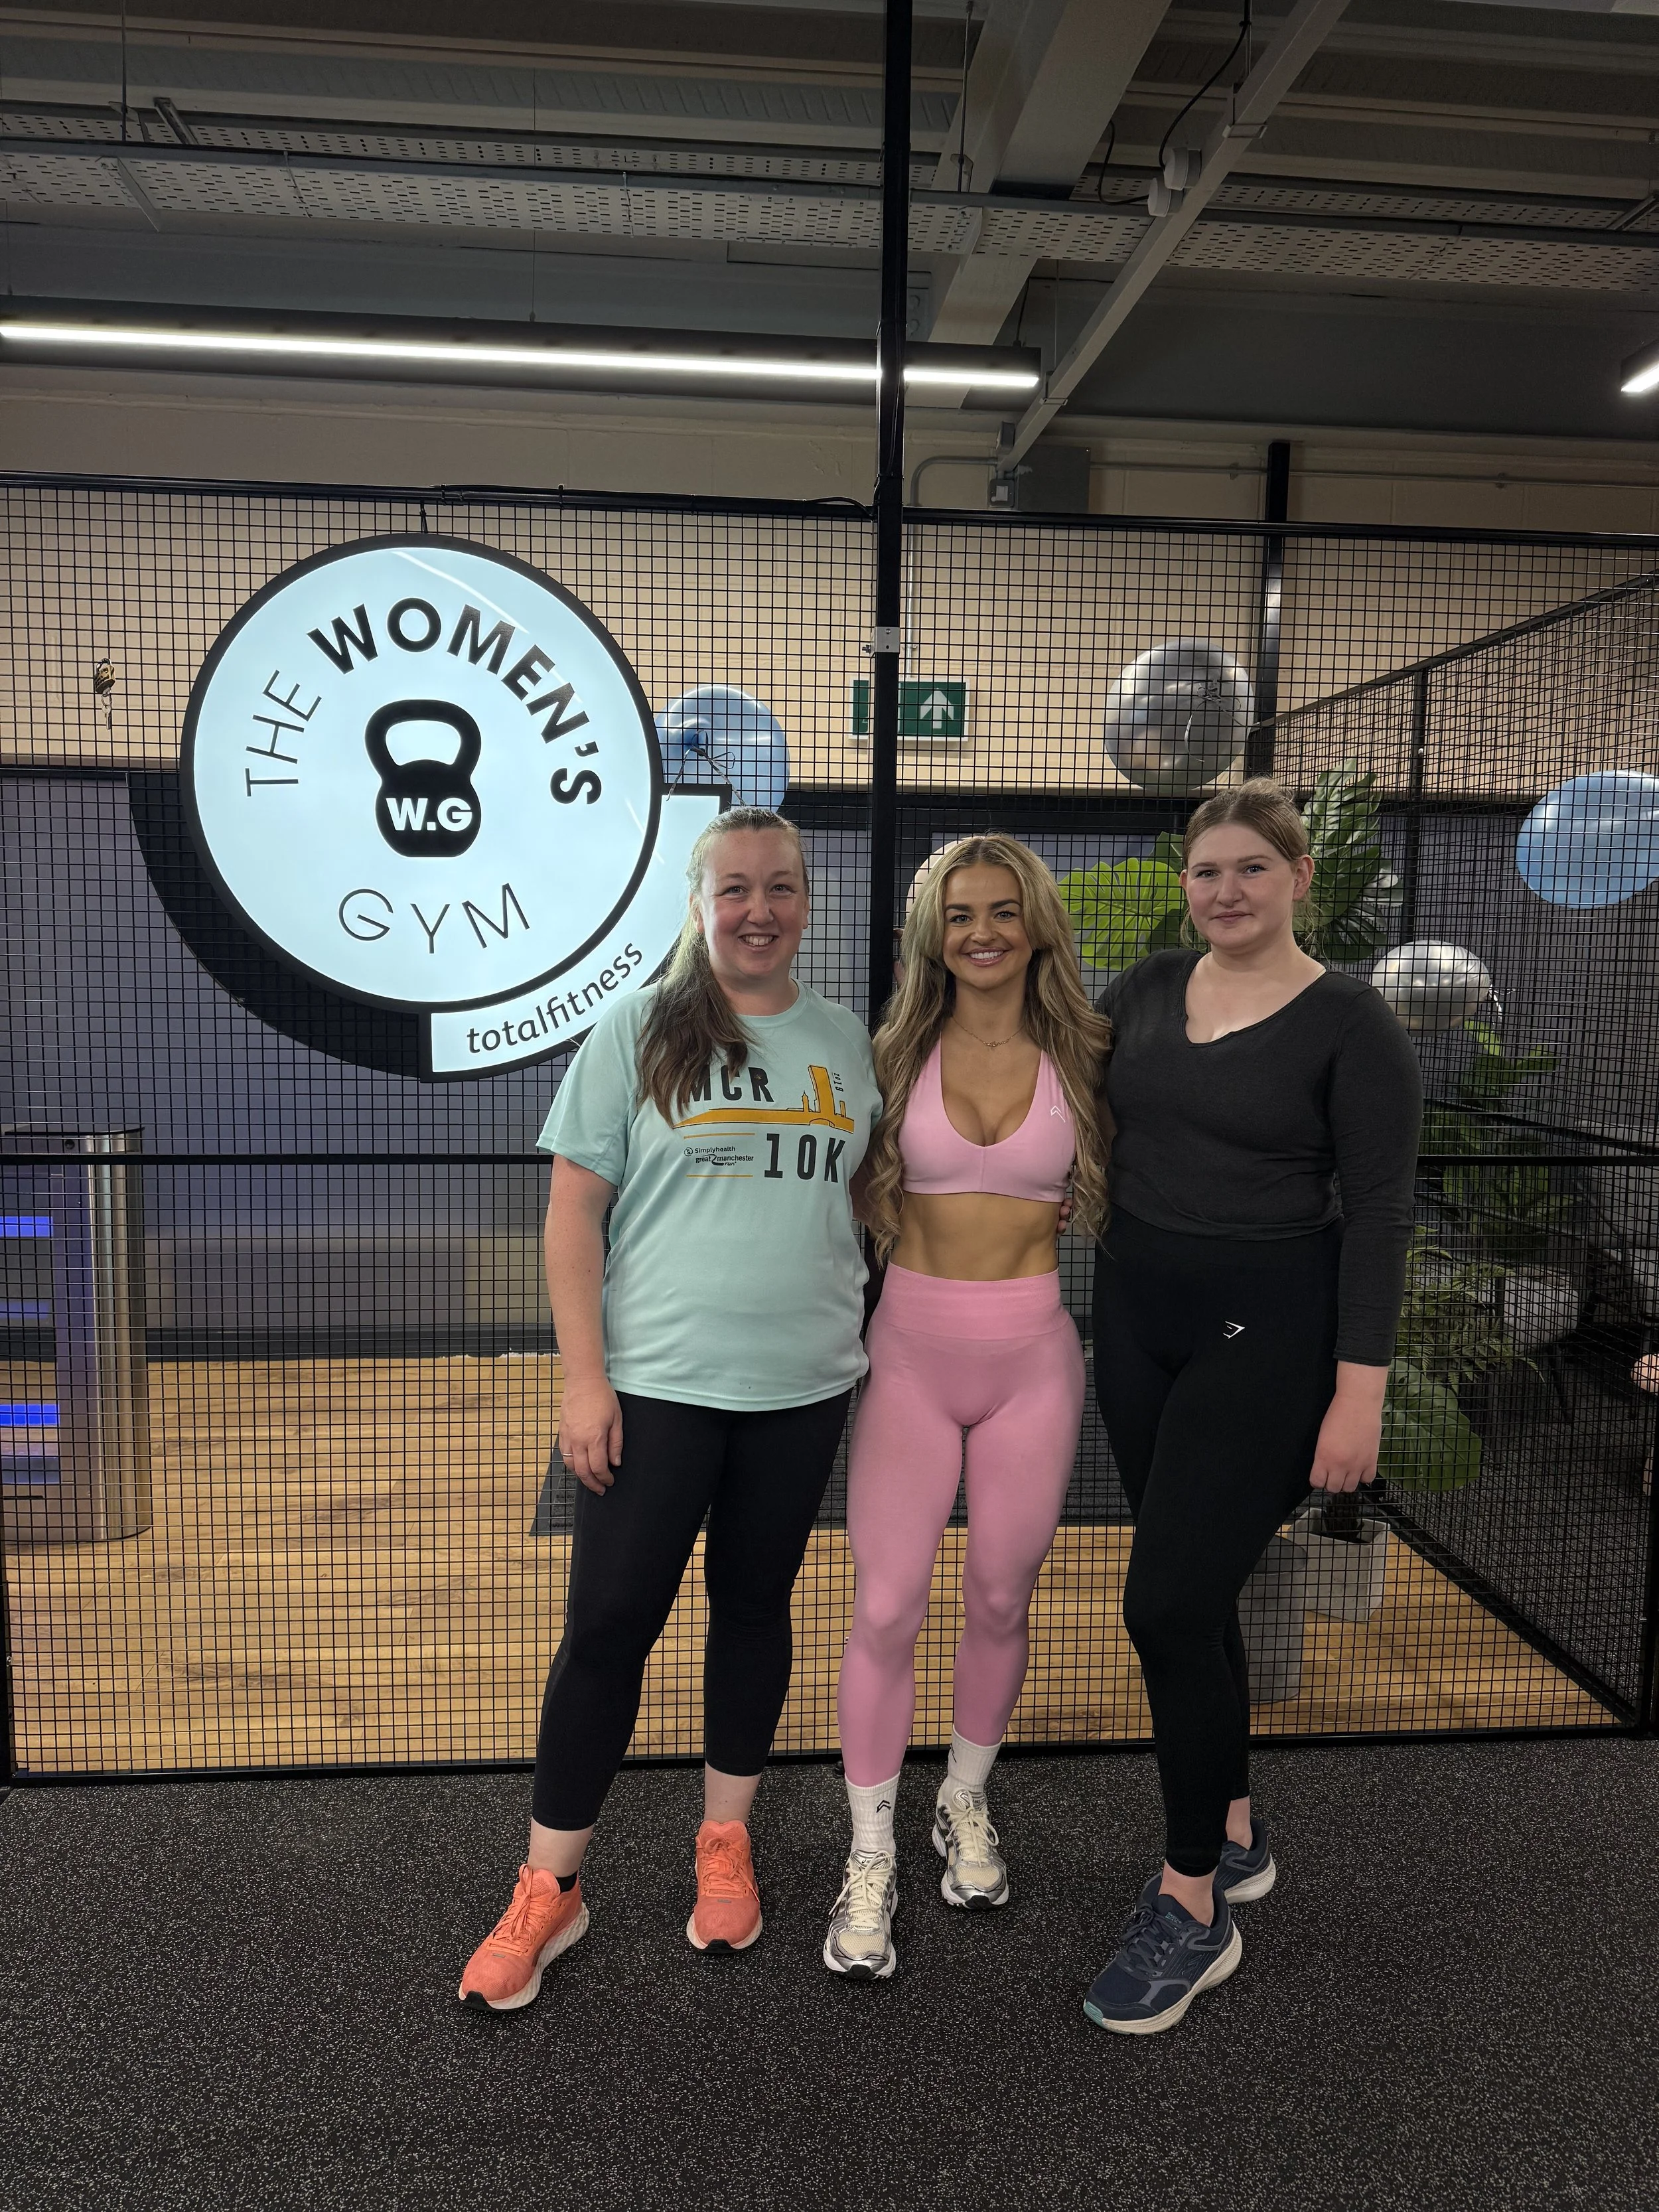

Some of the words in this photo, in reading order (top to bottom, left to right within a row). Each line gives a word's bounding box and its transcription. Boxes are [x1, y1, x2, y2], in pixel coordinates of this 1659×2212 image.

[245, 669, 322, 797] THE
[307, 597, 603, 805] WOMEN'S
[386, 797, 473, 832] W.G
[338, 882, 530, 954] GYM
[467, 942, 643, 1054] totalfitness
[764, 1133, 845, 1183] 10K
